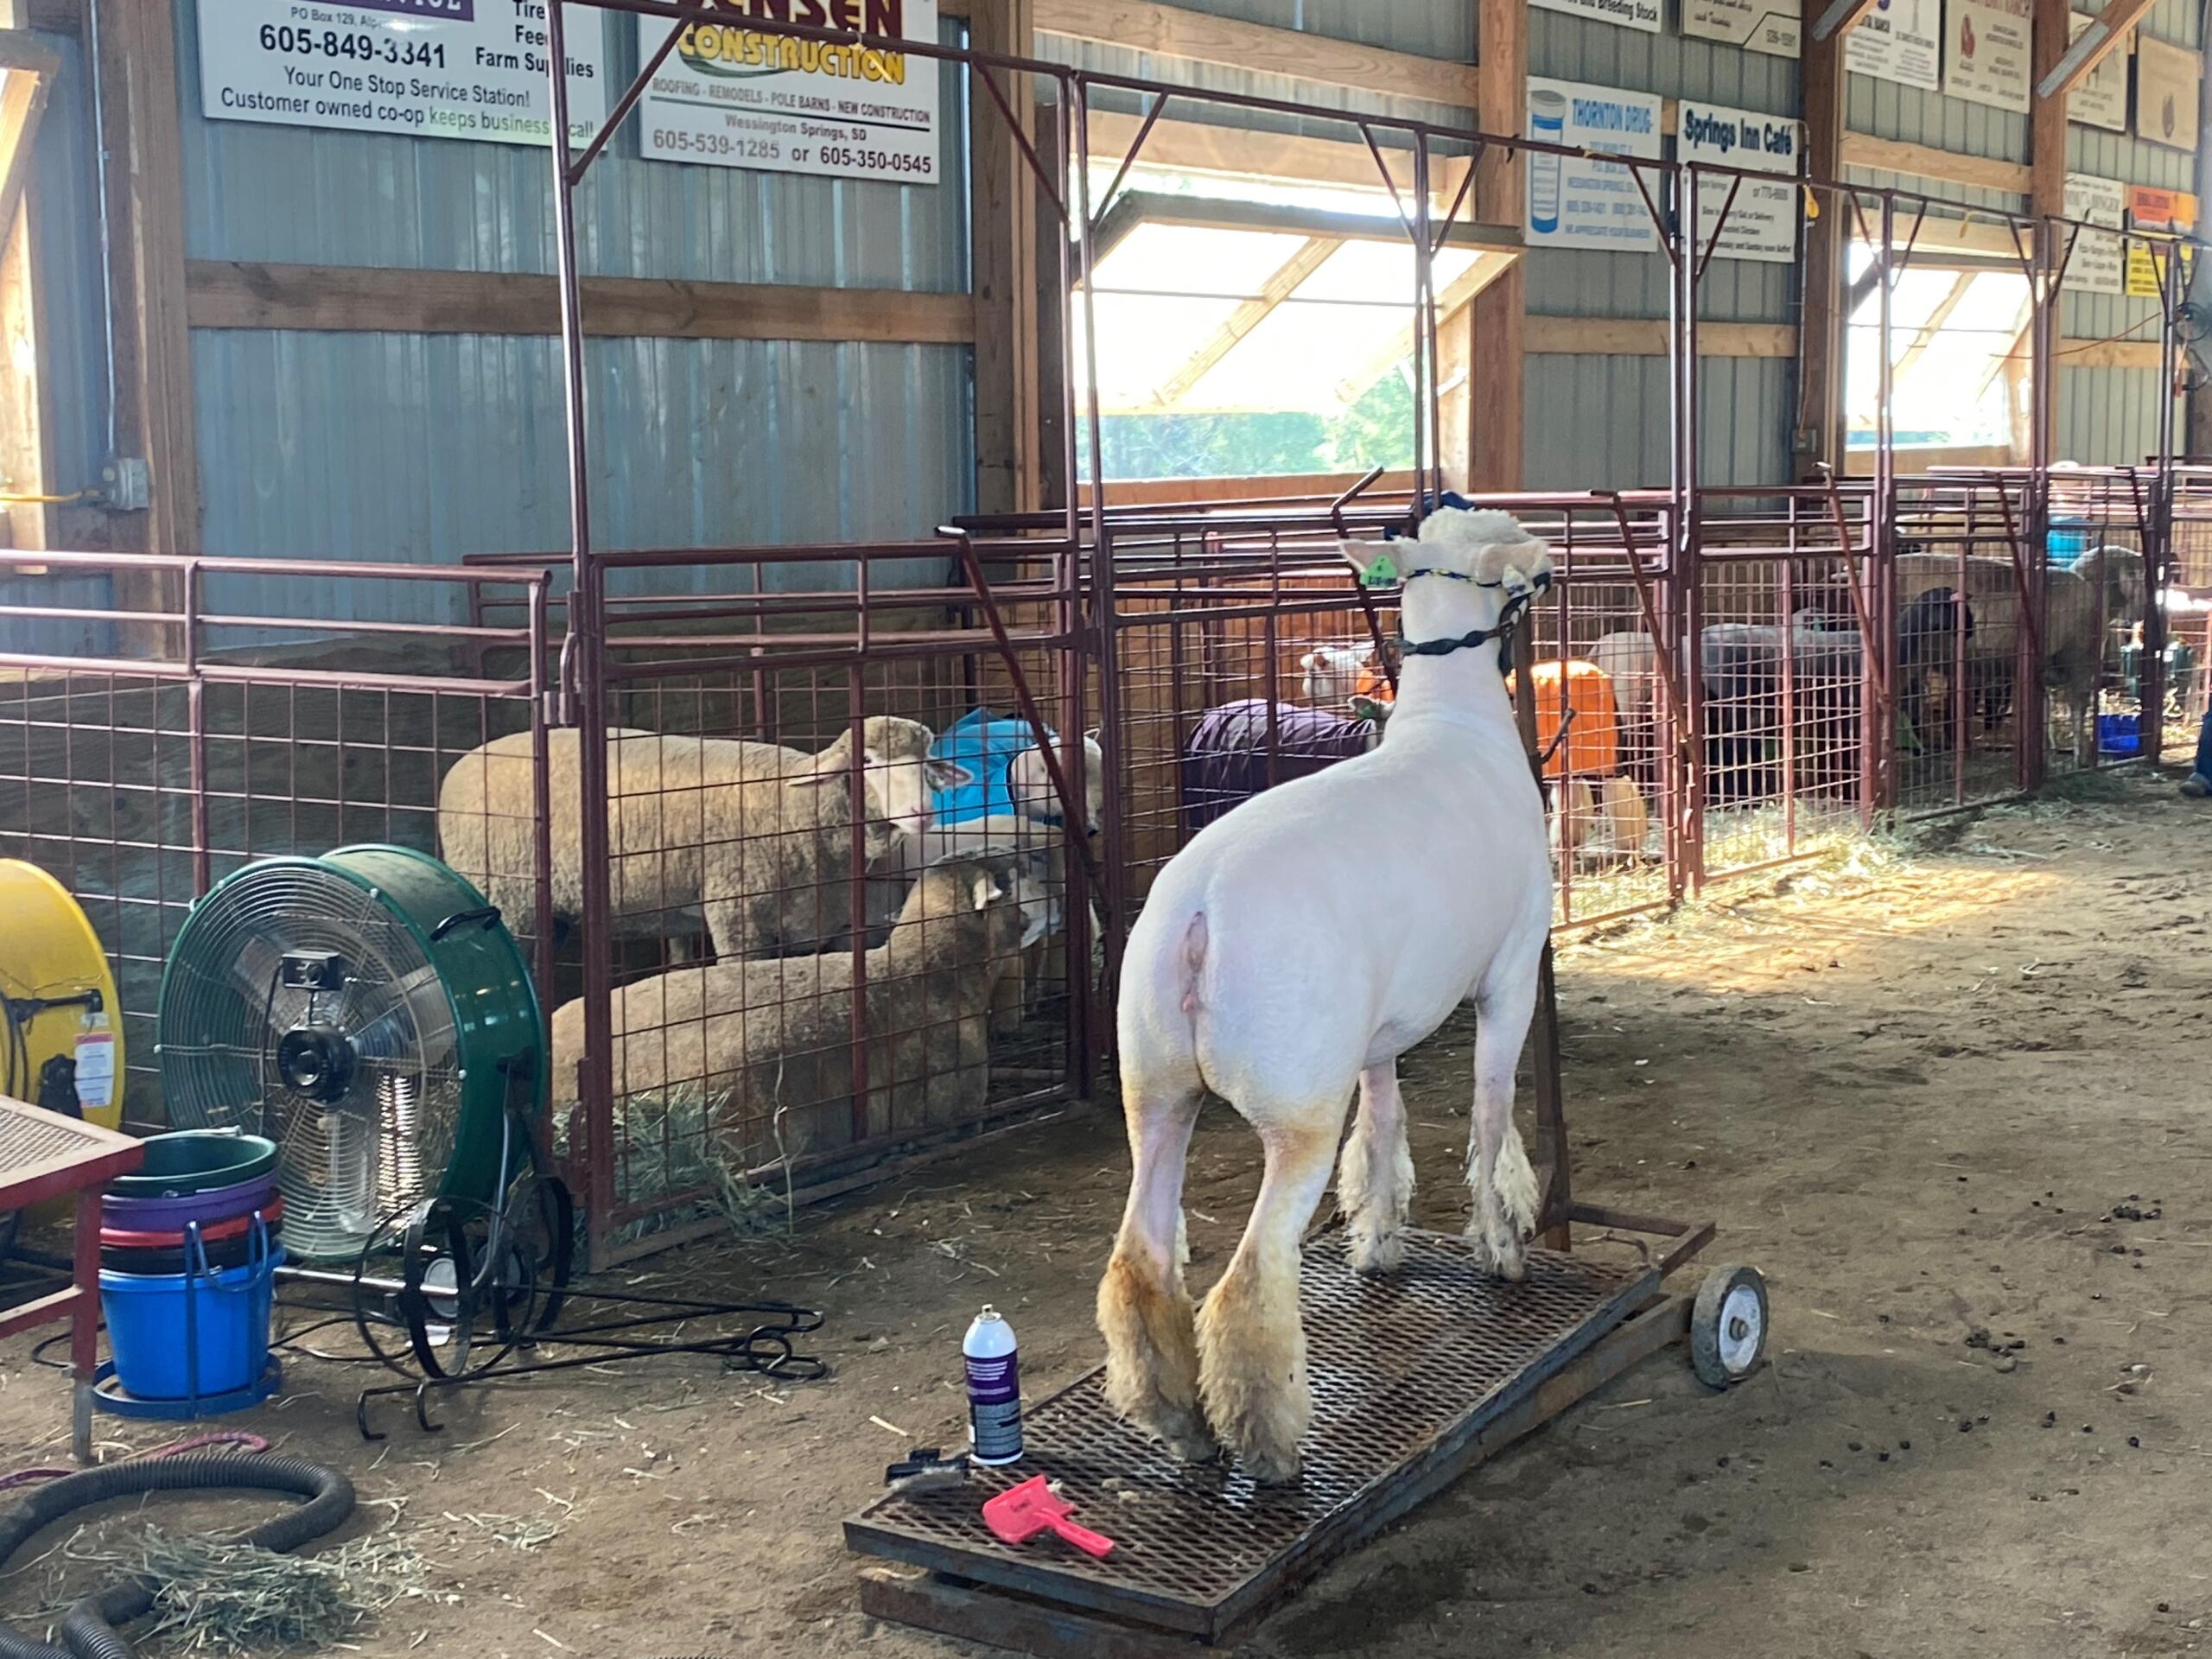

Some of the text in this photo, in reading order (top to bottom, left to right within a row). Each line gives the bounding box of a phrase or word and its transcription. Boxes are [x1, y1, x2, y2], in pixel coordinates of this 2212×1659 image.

[290, 6, 308, 20] PO
[311, 9, 333, 22] Box
[513, 0, 546, 19] Tire
[260, 23, 445, 69] 605-849-3341
[515, 24, 548, 46] Fee
[677, 22, 906, 85] CONSTRUCTION
[476, 47, 594, 79] Farm Sulies
[284, 65, 531, 108] Your One Stop Service Station!
[652, 77, 700, 96] ROOFING
[709, 84, 763, 104] REMODELS
[771, 92, 796, 108] POLE
[798, 95, 830, 111] BARNS
[838, 100, 859, 115] NEW
[861, 103, 931, 124] CONSTRUCTION
[221, 86, 309, 113] Customer
[315, 99, 372, 119] owned
[378, 104, 424, 127] co-op
[429, 105, 476, 131] keeps
[481, 111, 550, 135] business
[725, 113, 867, 142] Wessington Springs, SD
[1684, 109, 1736, 153] Springs
[1740, 118, 1760, 150] Inn
[653, 129, 931, 174] 605-539-1285 or 605-350-0545
